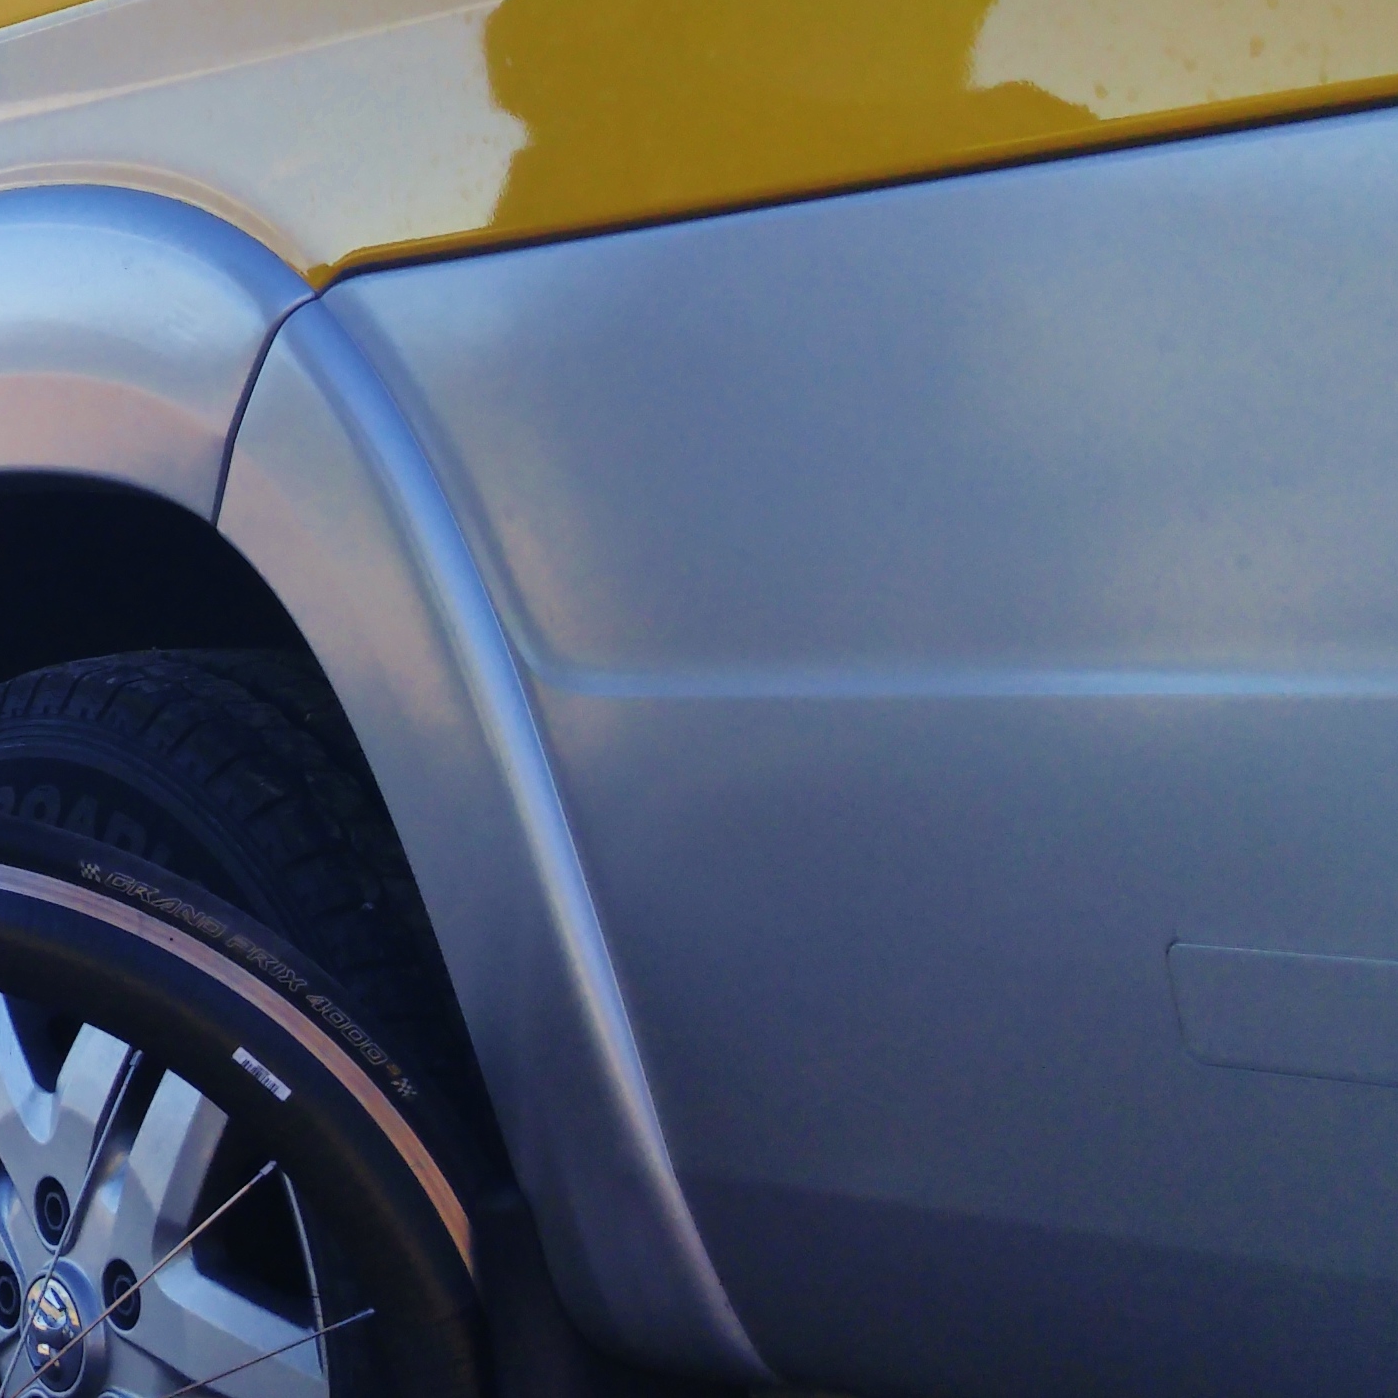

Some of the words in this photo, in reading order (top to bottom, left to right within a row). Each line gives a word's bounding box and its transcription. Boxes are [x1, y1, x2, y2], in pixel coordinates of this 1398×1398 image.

[106, 871, 228, 939] GRAND
[227, 934, 308, 992] PRIX
[306, 993, 388, 1065] 4000
